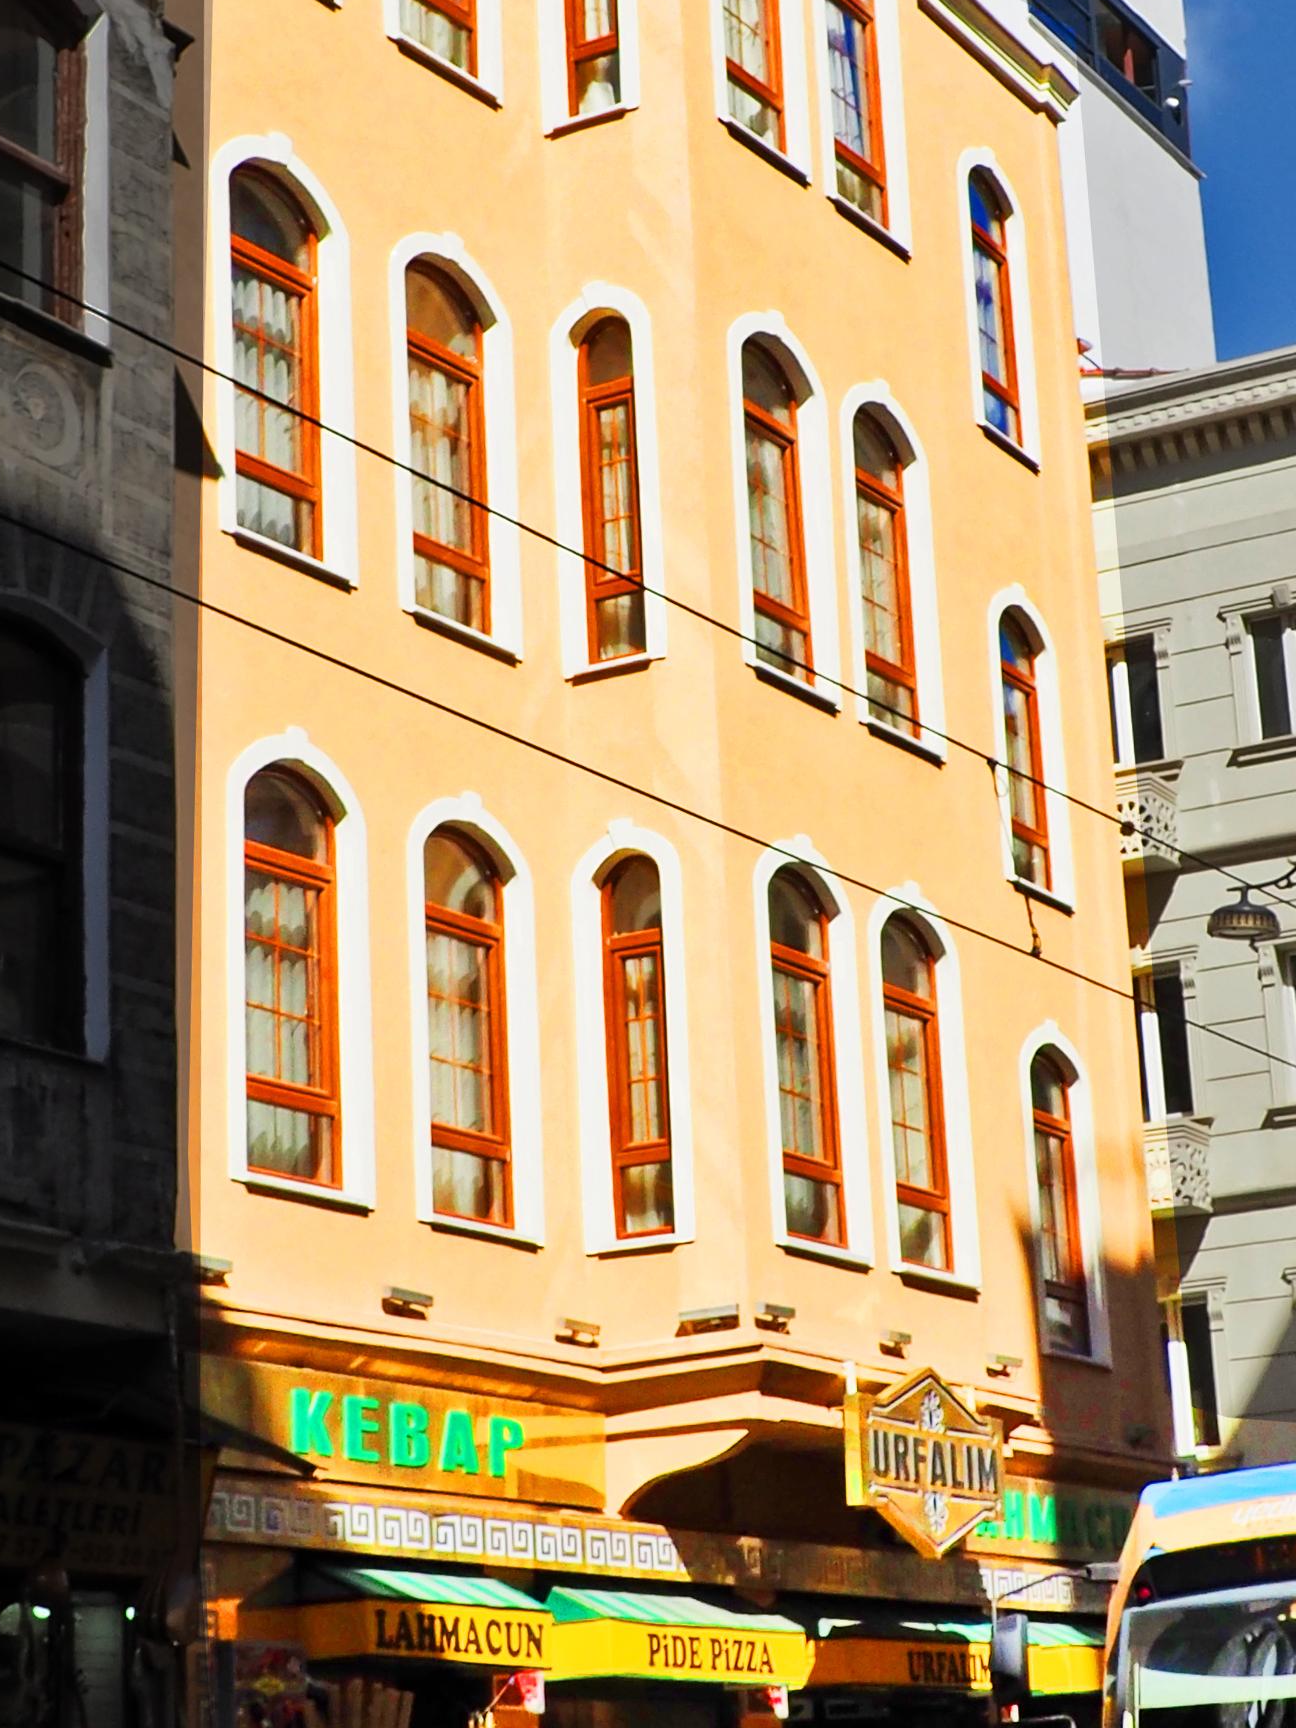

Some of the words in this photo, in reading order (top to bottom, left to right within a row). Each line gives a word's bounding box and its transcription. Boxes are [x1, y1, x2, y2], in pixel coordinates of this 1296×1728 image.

[290, 1387, 525, 1478] KEBAP
[869, 1428, 998, 1495] URFALIM
[375, 1609, 545, 1660] LAHMACUN
